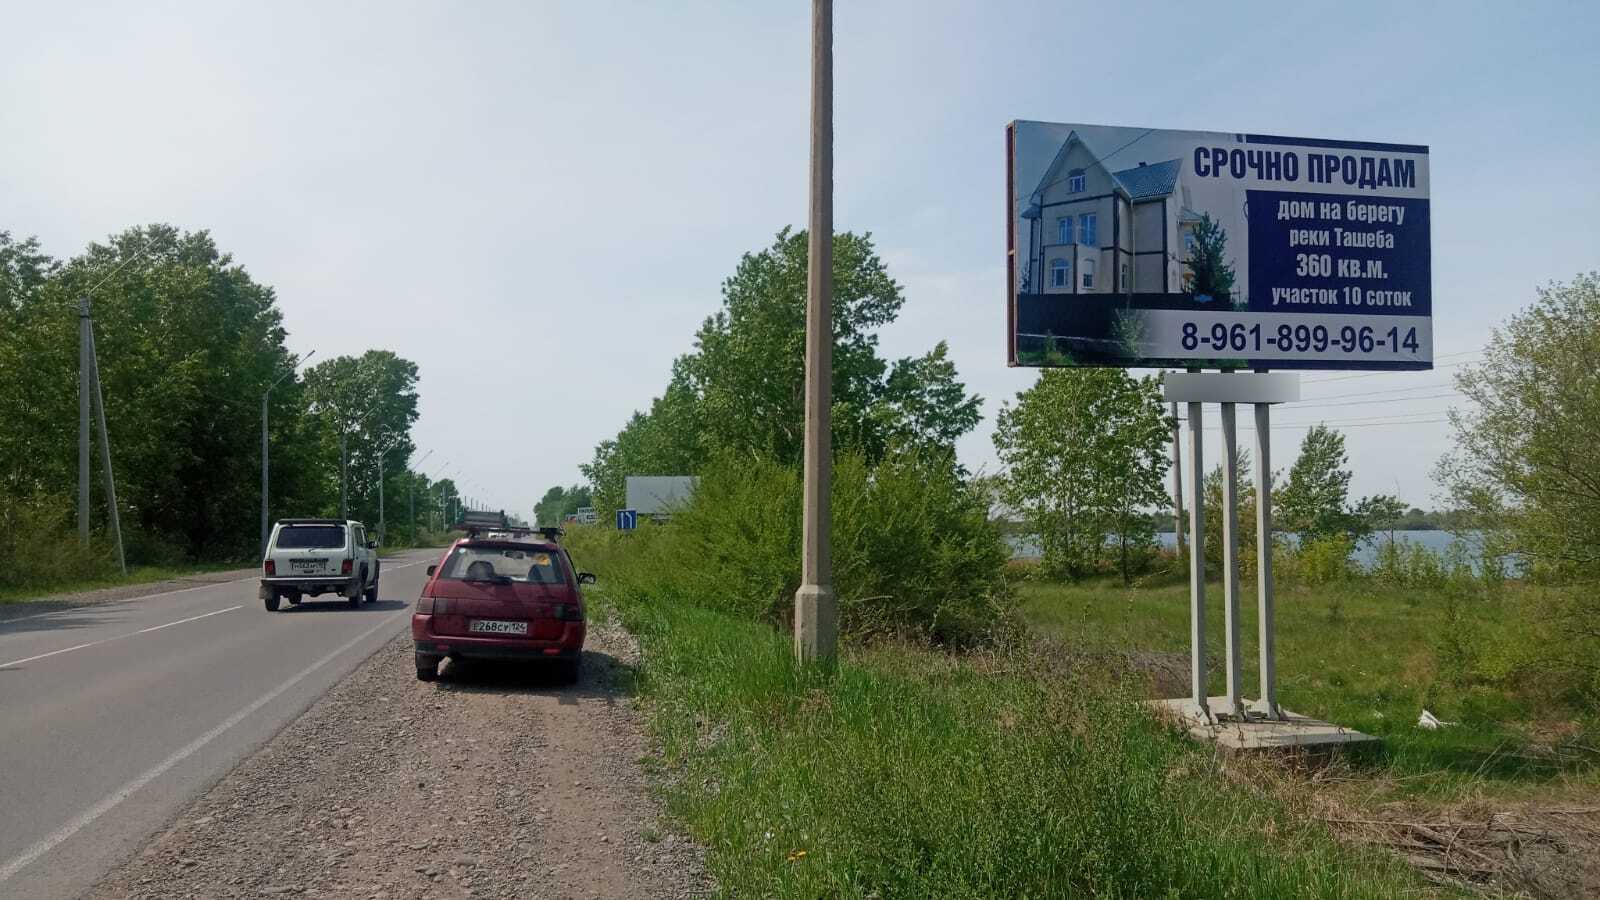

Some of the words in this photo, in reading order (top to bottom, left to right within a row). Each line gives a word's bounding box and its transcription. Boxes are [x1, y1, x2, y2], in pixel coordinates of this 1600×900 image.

[1194, 147, 1299, 182] СРОЧНО
[1307, 153, 1416, 190] ПРОДАМ
[1277, 200, 1315, 221] дом
[1320, 204, 1341, 220] на
[1346, 200, 1405, 225] берегу
[1289, 229, 1330, 247] реки
[1334, 228, 1394, 249] Ташеба
[1296, 253, 1332, 278] 360
[1337, 258, 1388, 279] кв.м.
[1272, 287, 1338, 307] участок
[1343, 287, 1362, 305] 10
[1366, 290, 1412, 307] соток
[1181, 322, 1420, 354] 8-961-899-96-14
